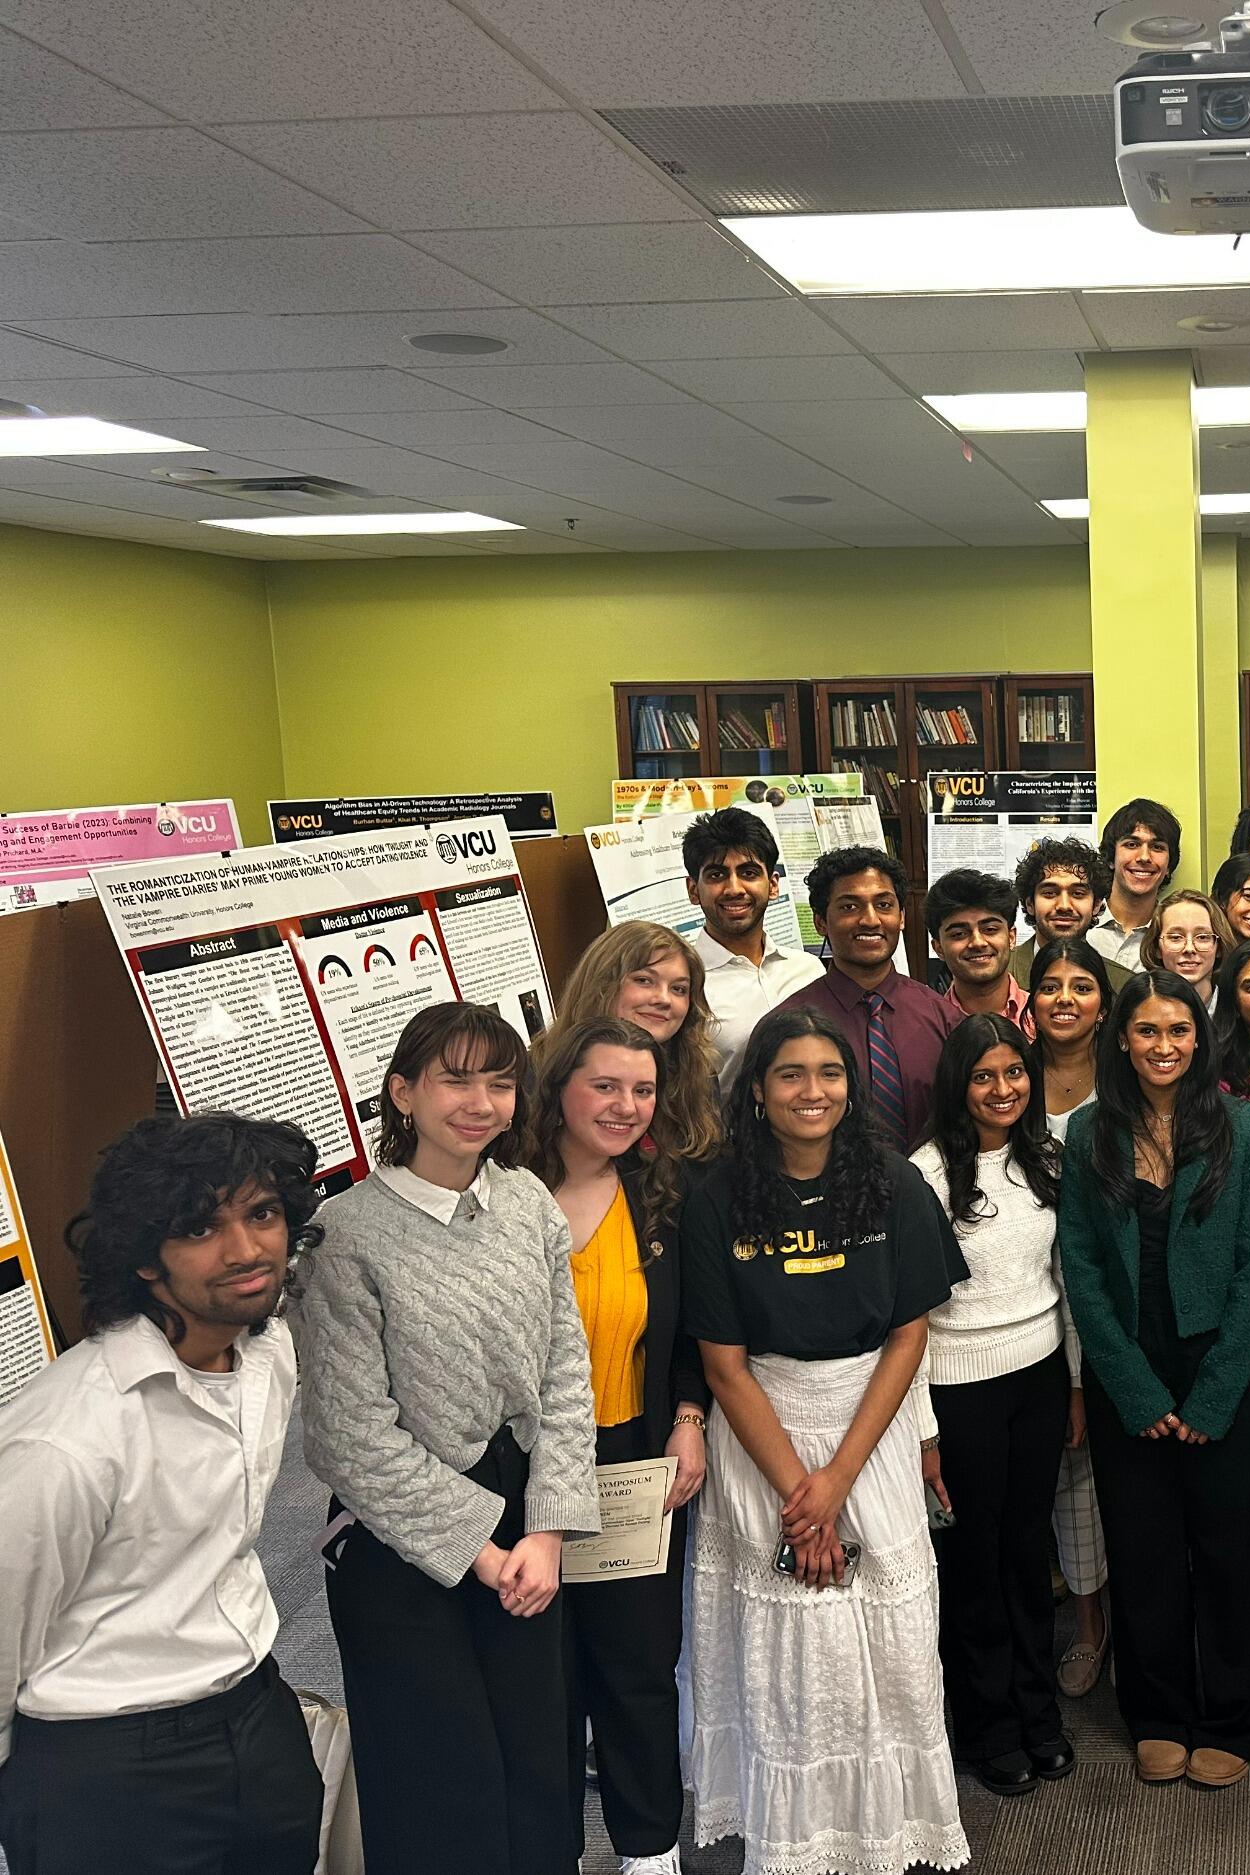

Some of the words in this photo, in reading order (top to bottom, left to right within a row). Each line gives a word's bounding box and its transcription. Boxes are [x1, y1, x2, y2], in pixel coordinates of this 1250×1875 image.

[800, 784, 823, 793] VCU
[950, 778, 984, 795] VCU
[953, 798, 973, 806] Honors
[975, 798, 995, 808] College
[3, 825, 39, 834] Success
[83, 819, 109, 829] (2023):
[112, 817, 152, 826] Combining
[174, 816, 216, 834] VCU
[290, 815, 322, 828] VCU
[10, 837, 26, 845] and
[29, 833, 81, 844] Engagement
[84, 828, 138, 840] Opportunities
[452, 830, 496, 859] VCU
[598, 831, 620, 846] VCU
[107, 882, 129, 895] THE
[129, 870, 217, 892] ROMANTICIZATION
[218, 868, 231, 878] OF
[231, 857, 301, 876] HUMAN-VAMPIRE
[368, 844, 385, 854] HOW
[415, 838, 428, 847] AND
[466, 862, 491, 875] Honors
[491, 858, 513, 870] College
[136, 889, 182, 904] VAMPIRE
[221, 879, 241, 890] MAY
[242, 874, 269, 887] PRIME
[269, 869, 299, 882] YOUNG
[300, 864, 330, 878] WOMEN
[331, 861, 344, 871] TO
[346, 857, 375, 869] ACCEPT
[377, 853, 399, 864] DATING
[399, 849, 428, 860] VIOLENCE
[456, 886, 501, 904] Sexualization
[121, 911, 142, 920] Natalie
[144, 908, 162, 917] Bowen
[125, 919, 148, 930] Virginia
[149, 912, 189, 926] Commonwealth
[191, 908, 215, 918] University,
[216, 904, 233, 913] Honors
[234, 900, 253, 910] College
[321, 915, 350, 931] Media
[351, 911, 368, 924] and
[368, 904, 408, 921] Violence
[190, 937, 236, 958] Abstract
[598, 1476, 652, 1488] SYMPOSIUM
[609, 1559, 630, 1567] VCU
